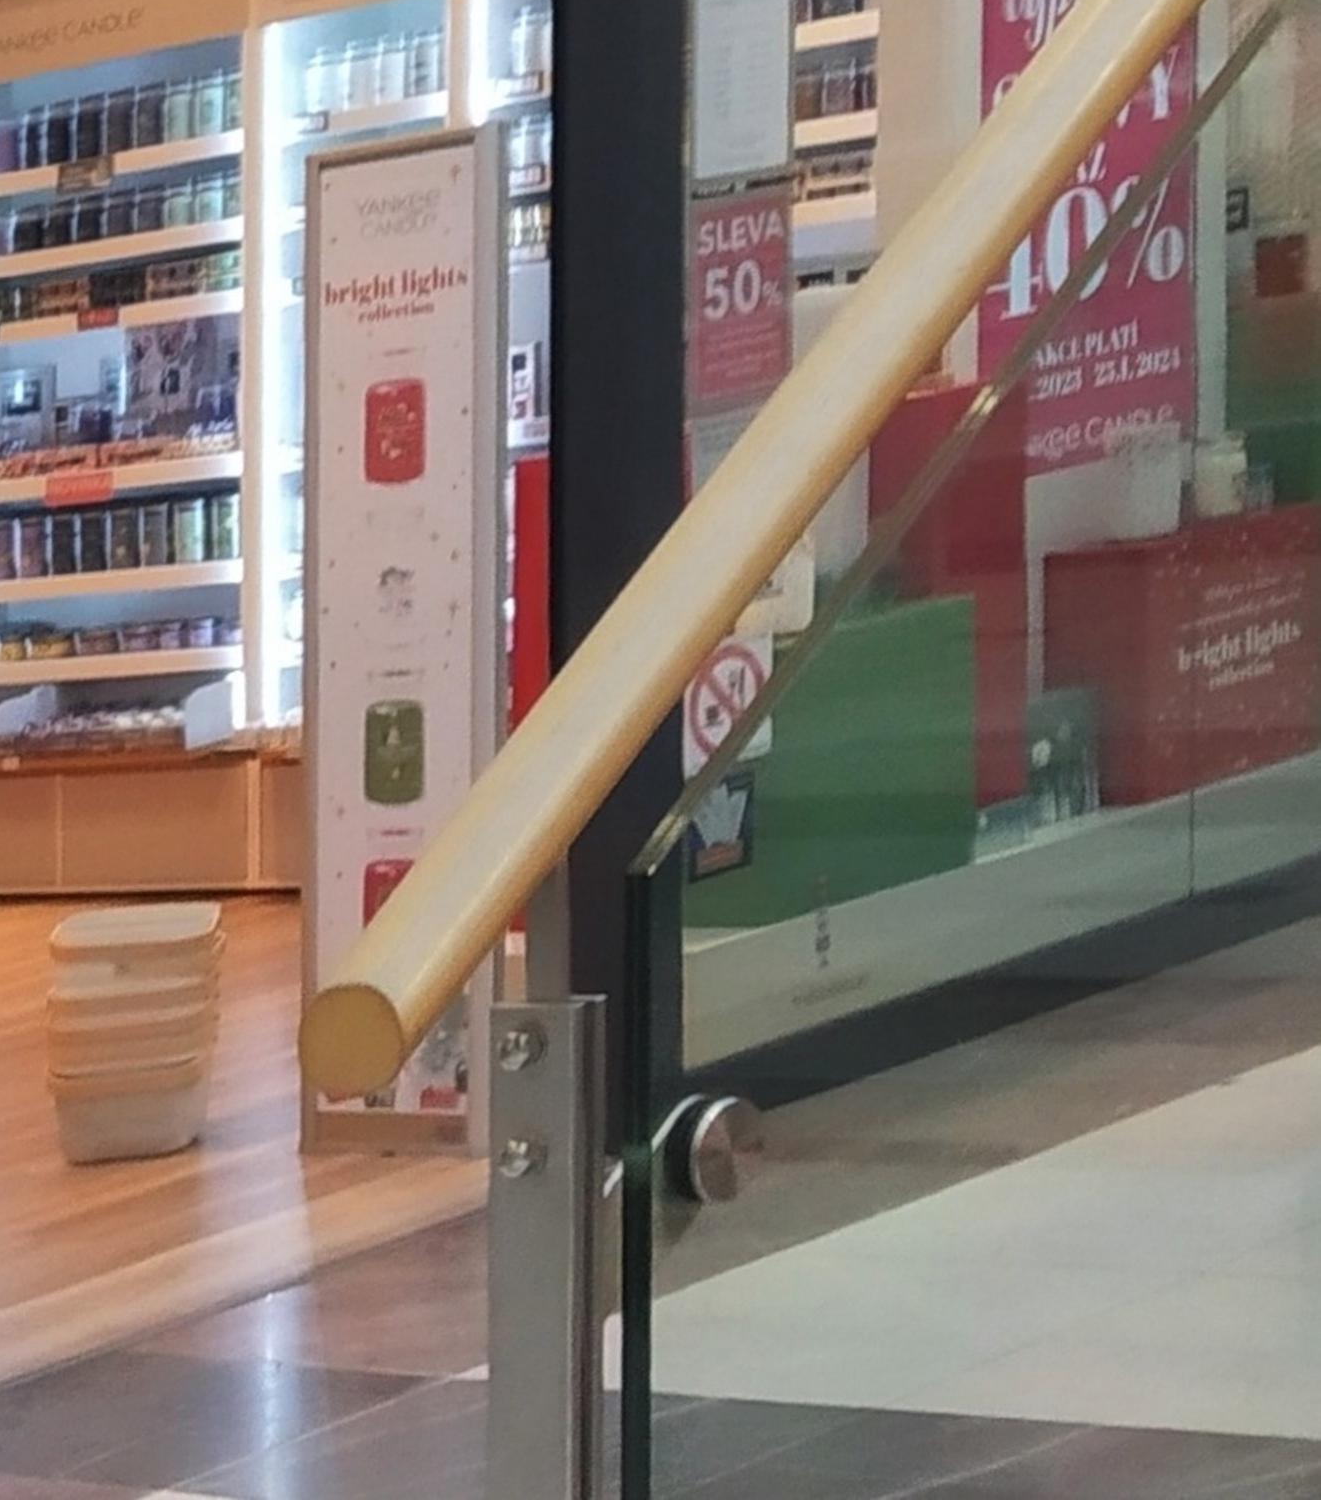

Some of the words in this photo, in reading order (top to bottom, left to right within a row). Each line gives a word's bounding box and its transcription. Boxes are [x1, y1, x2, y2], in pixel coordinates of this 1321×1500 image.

[698, 208, 785, 256] SLEVA
[325, 274, 395, 307] bright
[401, 266, 468, 298] lights
[704, 259, 782, 322] 50%
[359, 299, 435, 324] collection
